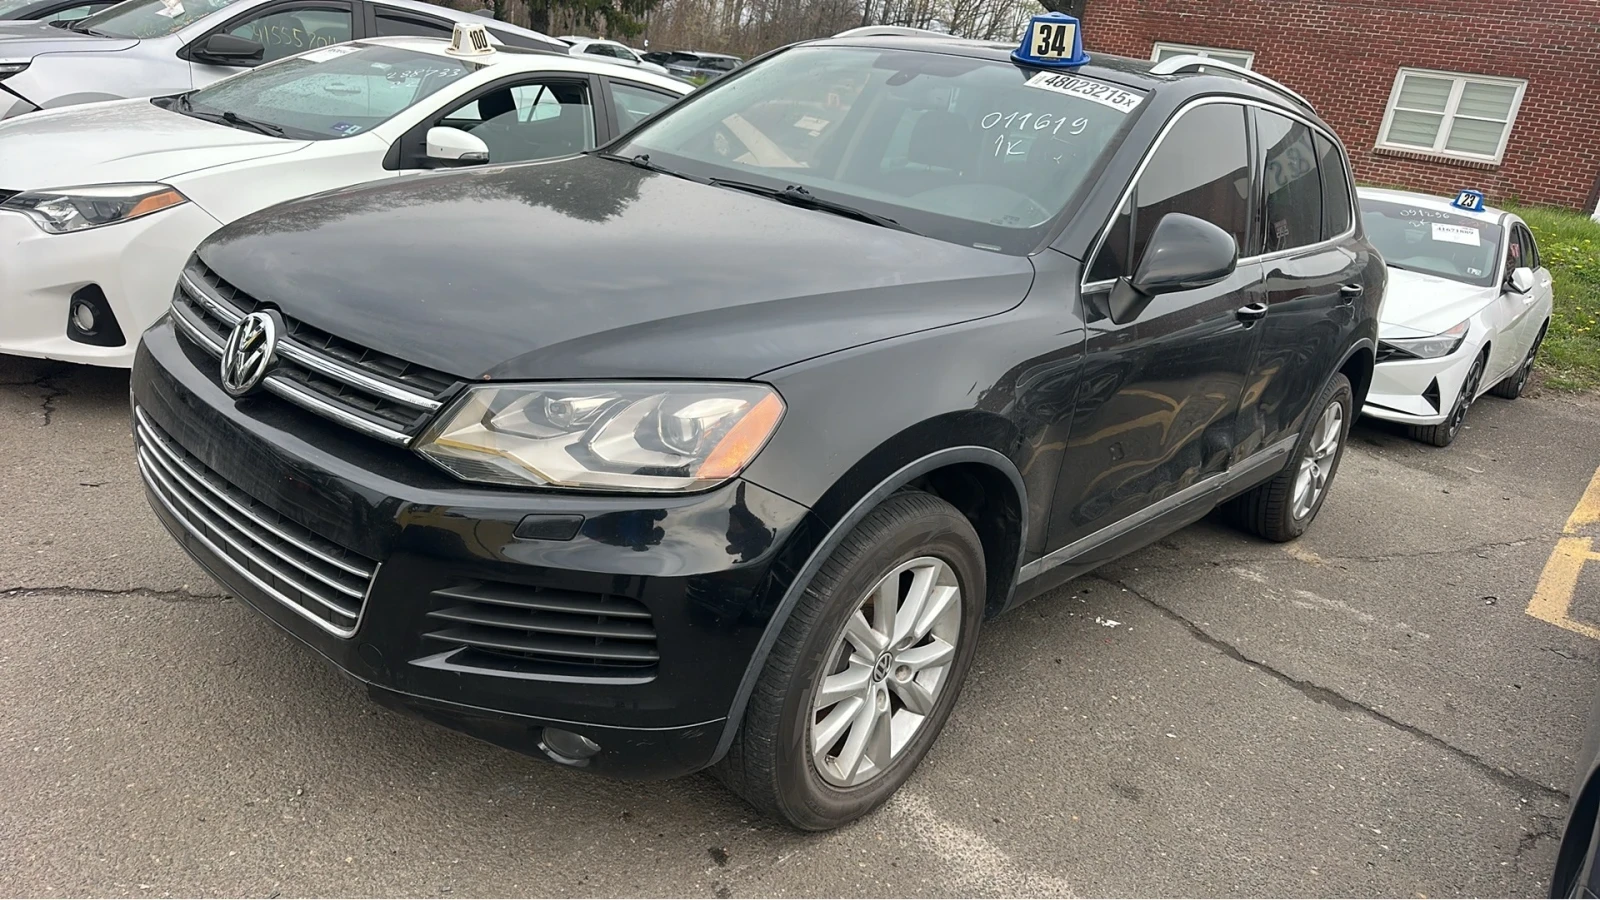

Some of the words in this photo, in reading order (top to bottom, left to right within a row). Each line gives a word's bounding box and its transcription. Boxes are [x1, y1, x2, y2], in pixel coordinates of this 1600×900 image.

[469, 29, 488, 51] 100
[1037, 24, 1066, 57] 34
[981, 111, 1088, 136] 011619
[1461, 194, 1476, 207] 23
